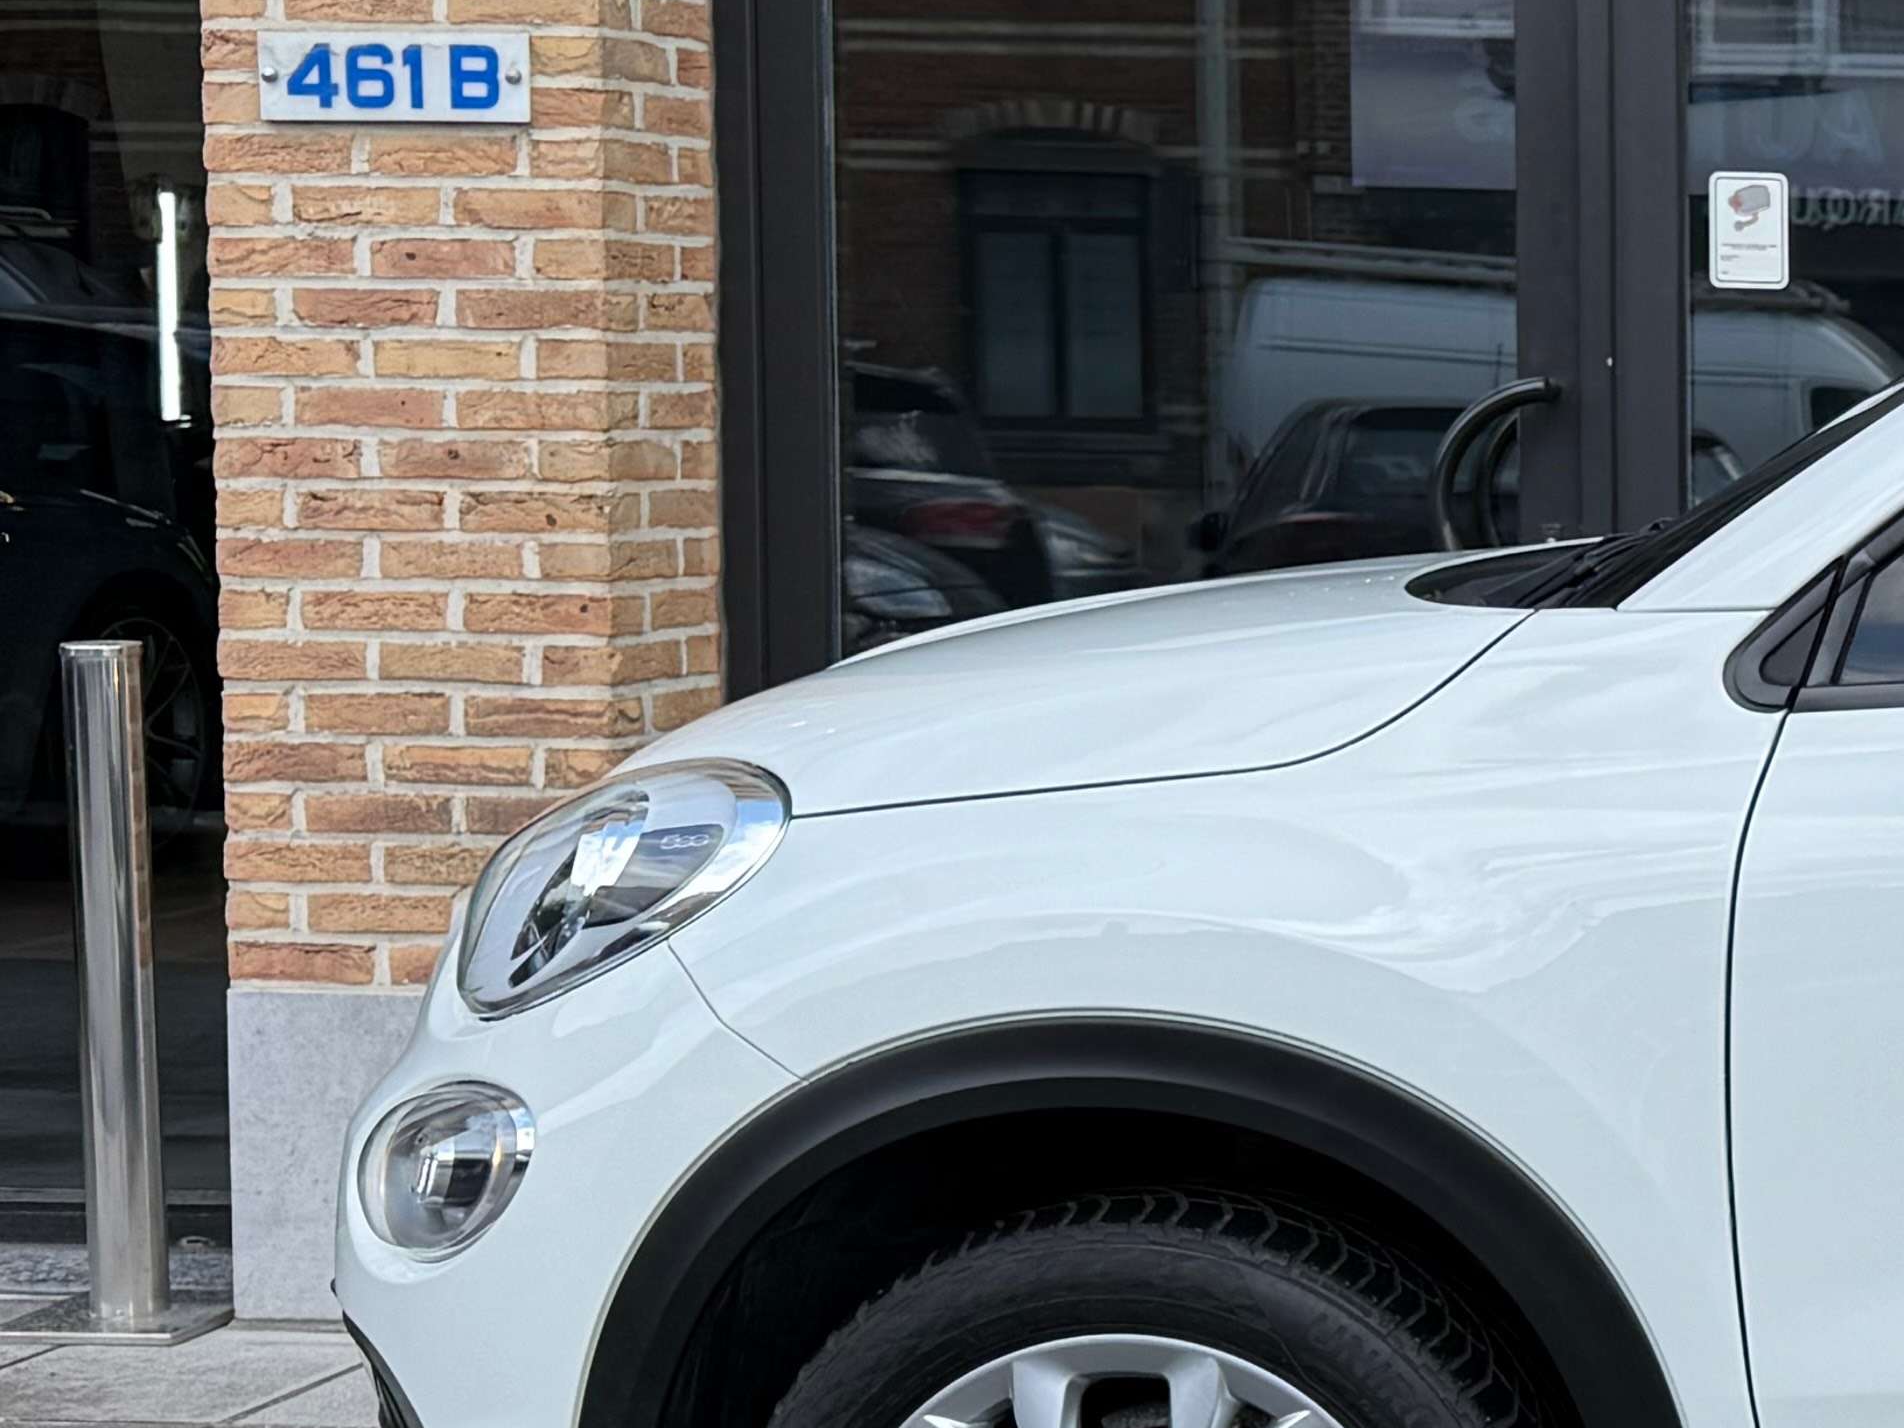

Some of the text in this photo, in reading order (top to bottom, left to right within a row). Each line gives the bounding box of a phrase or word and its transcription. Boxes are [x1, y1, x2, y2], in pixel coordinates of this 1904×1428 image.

[287, 43, 500, 109] 461 B
[659, 834, 710, 850] 500
